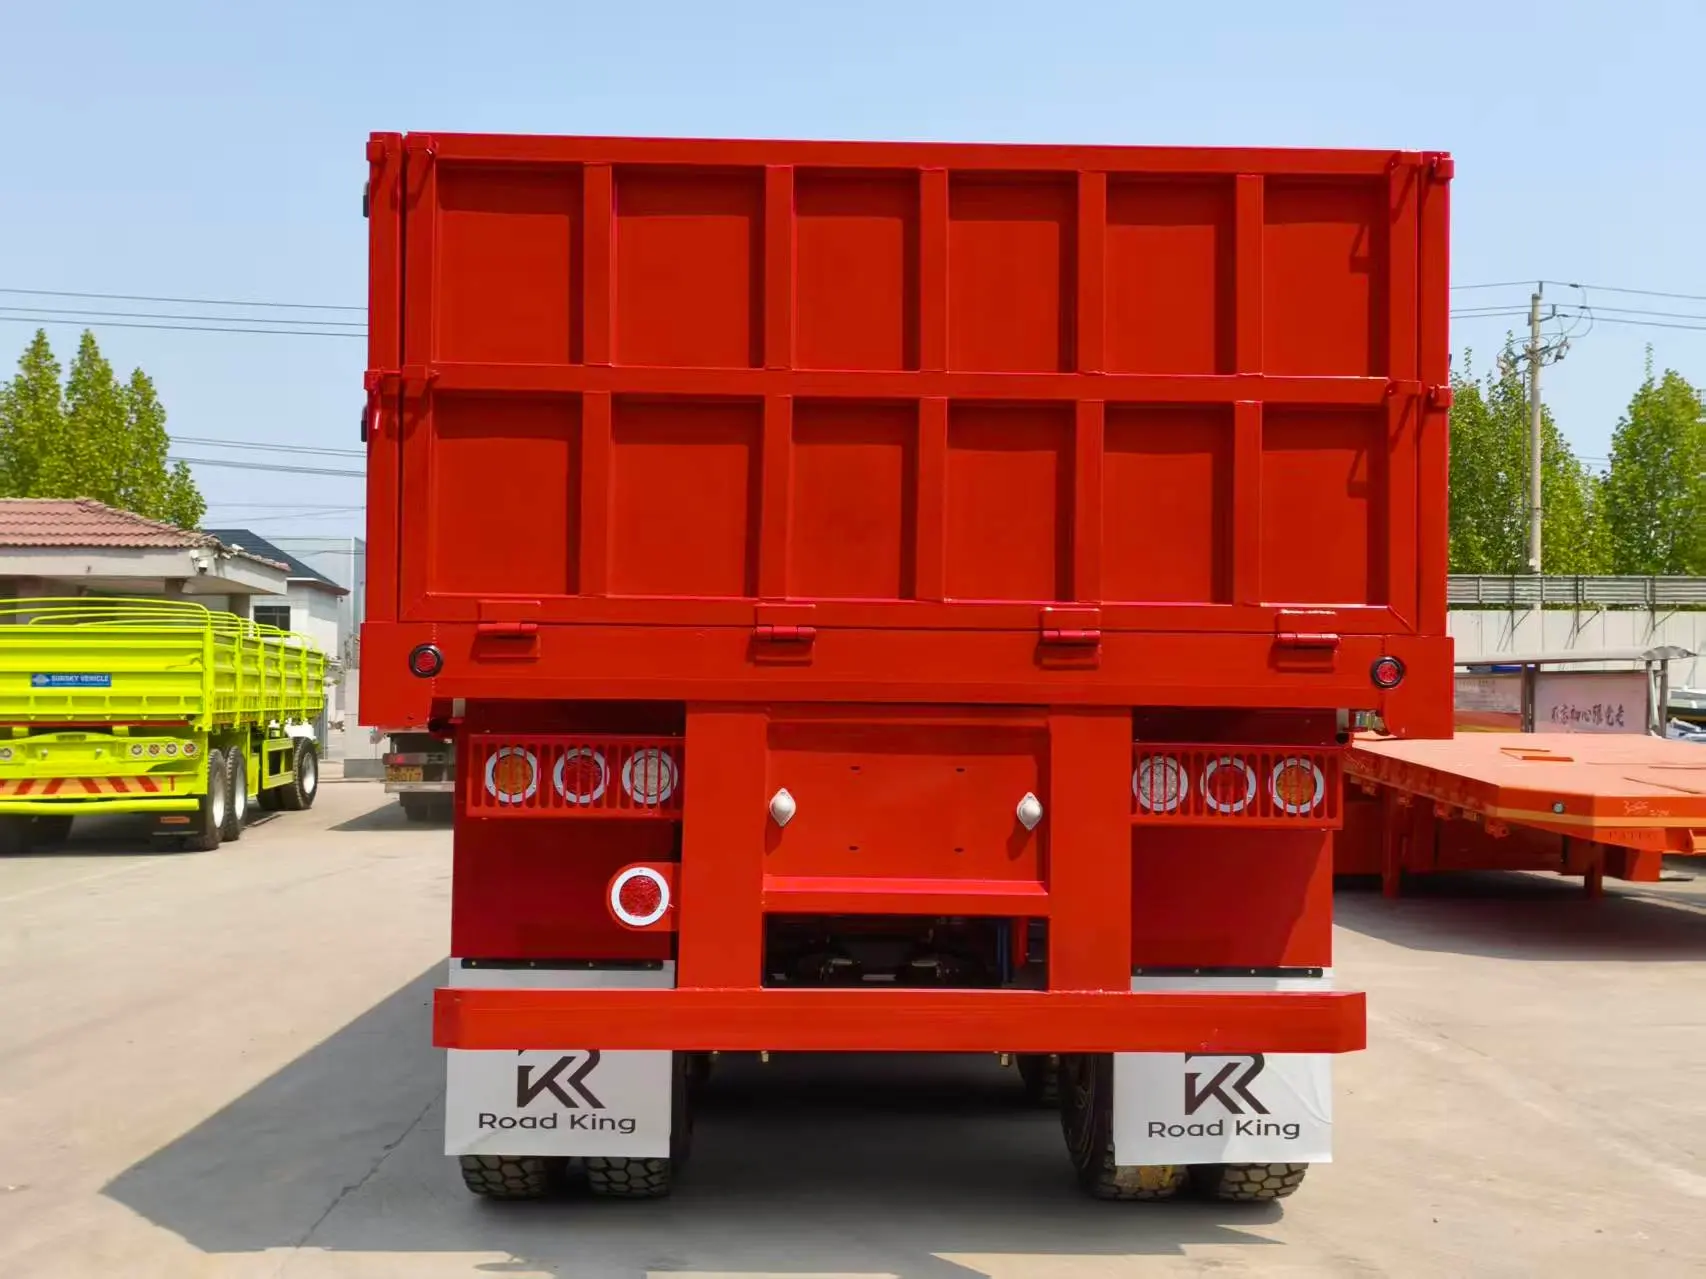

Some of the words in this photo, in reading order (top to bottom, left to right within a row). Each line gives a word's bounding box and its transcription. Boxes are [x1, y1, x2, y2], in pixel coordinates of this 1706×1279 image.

[478, 1112, 558, 1131] Road
[570, 1113, 637, 1134] King
[1147, 1119, 1225, 1138] Road
[1235, 1119, 1301, 1140] King
